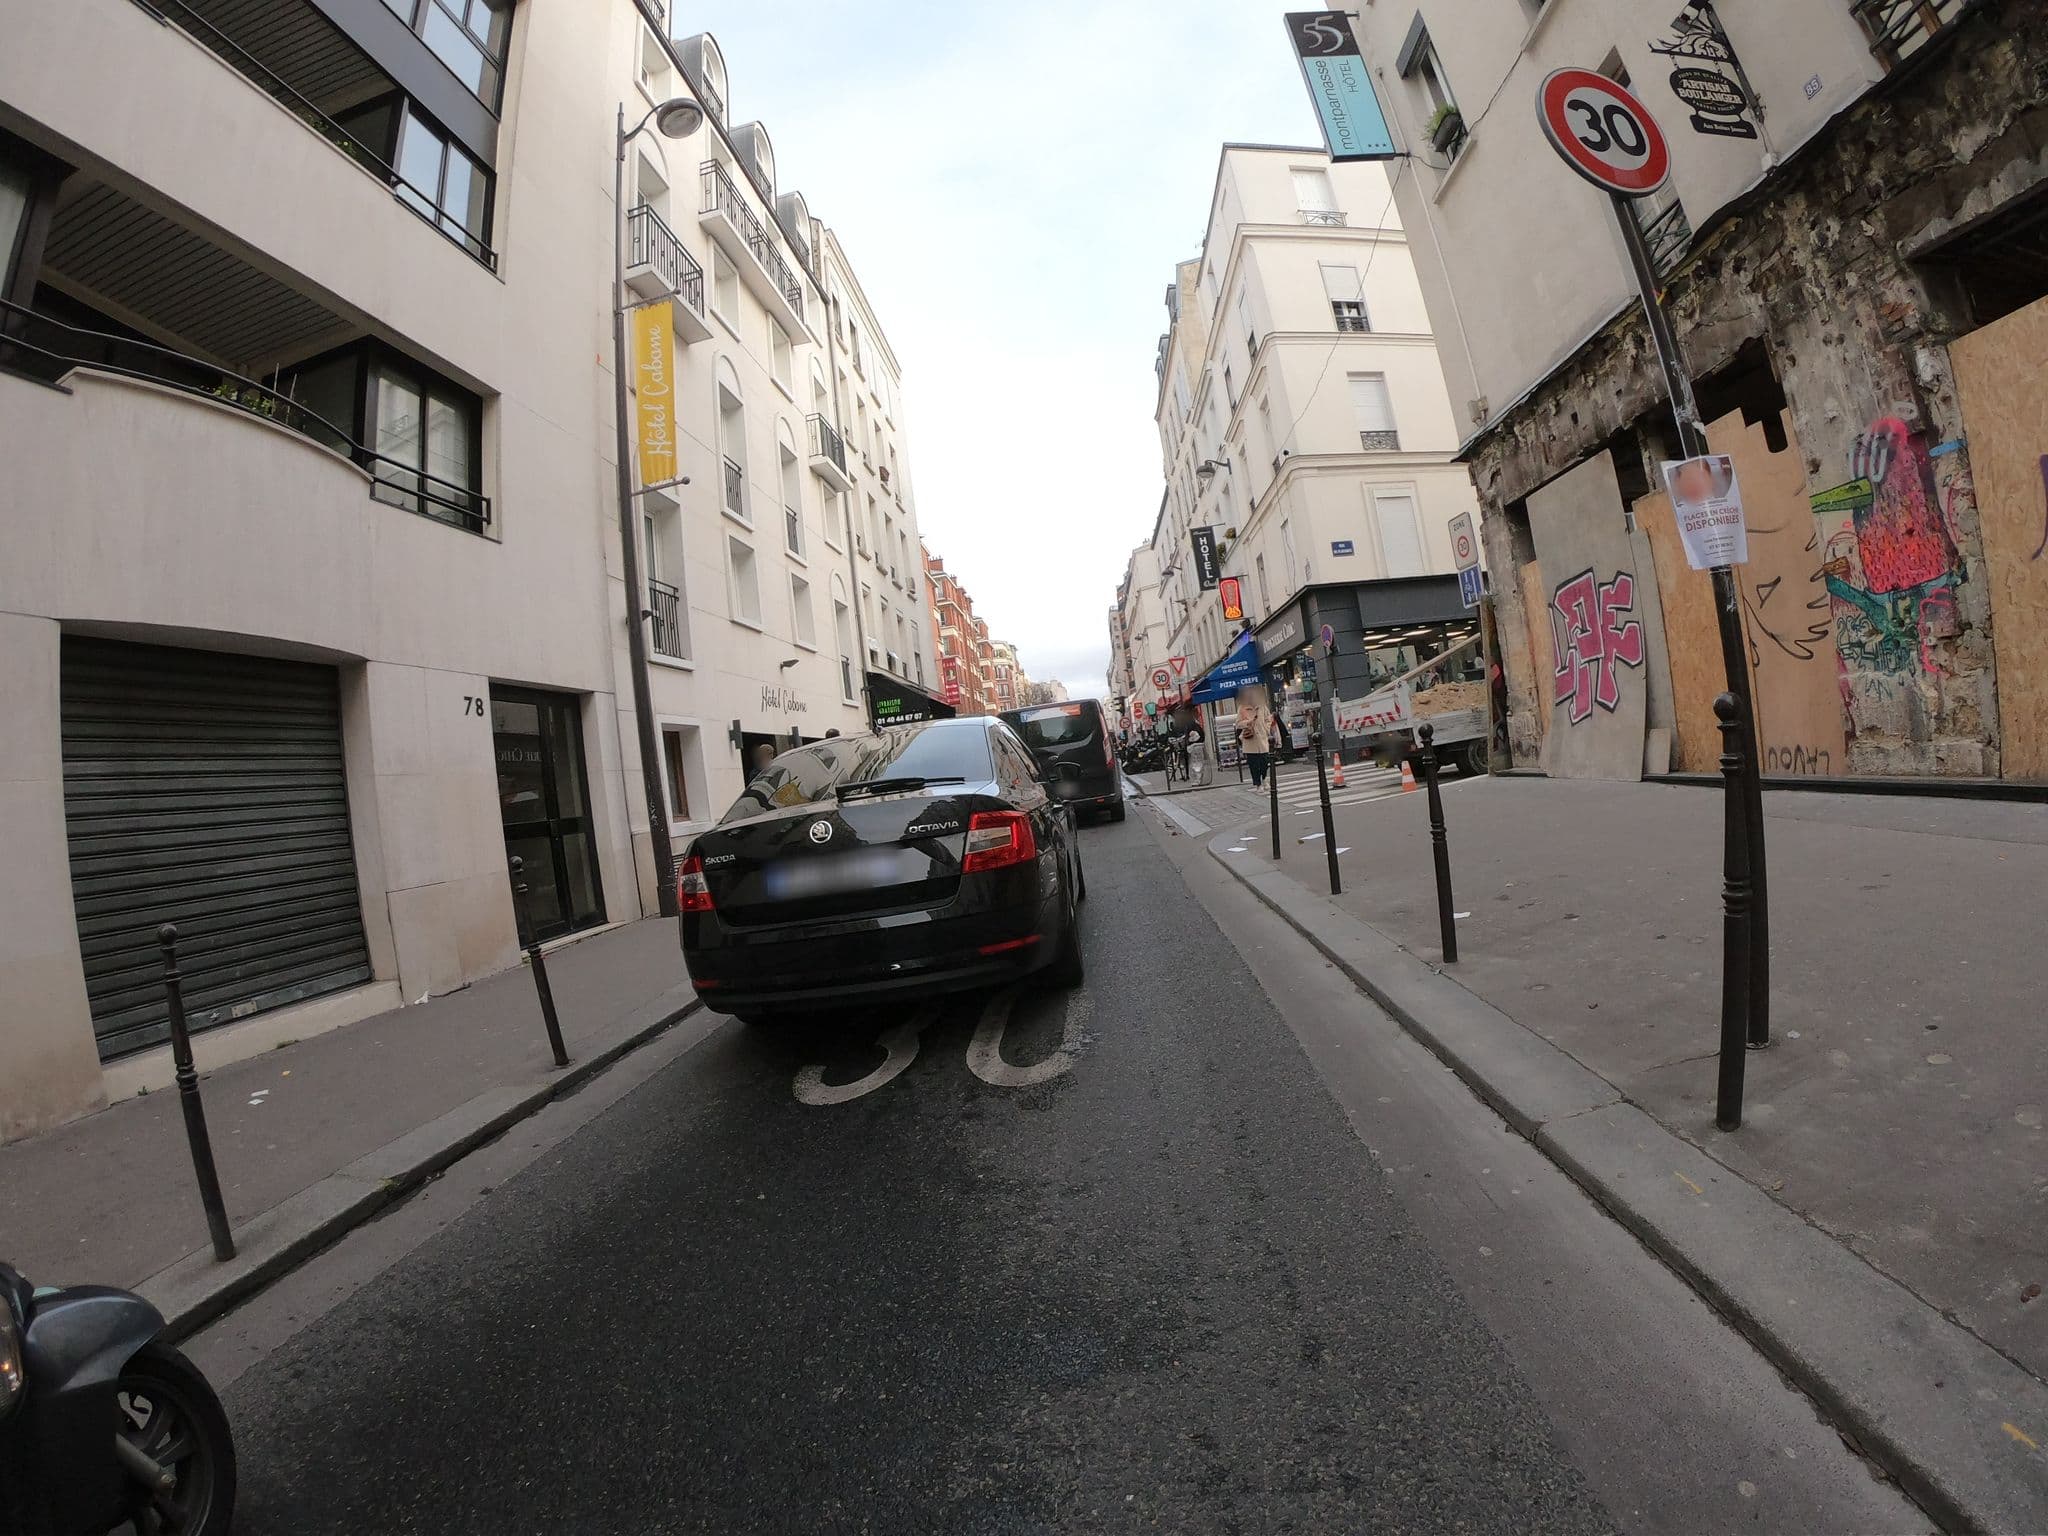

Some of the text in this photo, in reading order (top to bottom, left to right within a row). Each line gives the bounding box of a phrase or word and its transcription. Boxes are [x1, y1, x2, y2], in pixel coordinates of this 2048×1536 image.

[1303, 15, 1344, 53] 55
[1339, 60, 1359, 93] HÔTEL
[1681, 79, 1731, 93] ARTISAN
[1805, 79, 1819, 96] 85
[1677, 88, 1743, 104] BOULANGER
[1316, 60, 1355, 150] montparnasse
[1567, 99, 1647, 156] 30
[643, 403, 672, 457] Hôtel
[1453, 520, 1465, 531] ZONE
[1685, 515, 1740, 532] DISPONIBLES
[1199, 536, 1214, 579] HOTEL
[1157, 674, 1167, 682] 30
[1220, 680, 1237, 688] PIZZA
[464, 696, 484, 717] 78
[908, 820, 960, 835] OCTAVIA
[705, 853, 736, 866] ŠKODA
